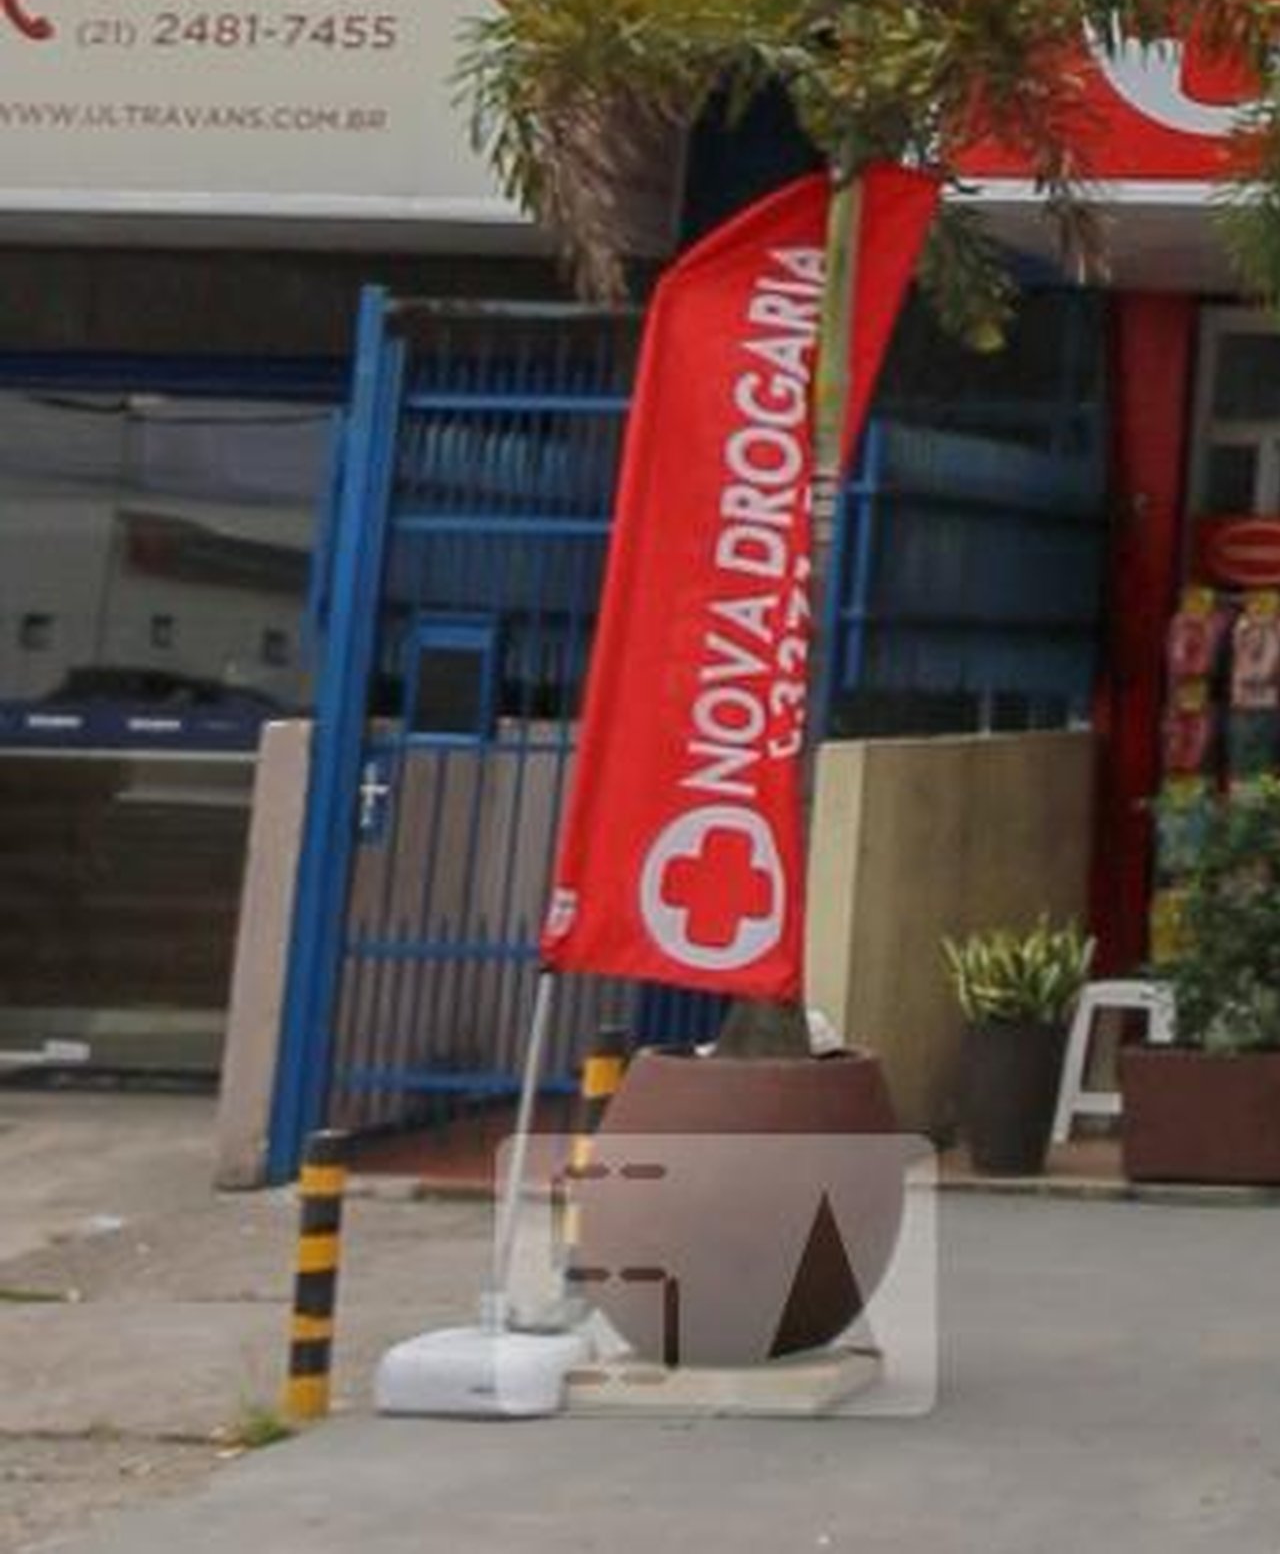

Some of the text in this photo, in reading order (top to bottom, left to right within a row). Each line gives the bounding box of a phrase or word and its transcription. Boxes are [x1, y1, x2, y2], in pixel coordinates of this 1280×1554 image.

[153, 12, 397, 50] 2481-7455
[679, 246, 828, 797] NOVA DROGARIA
